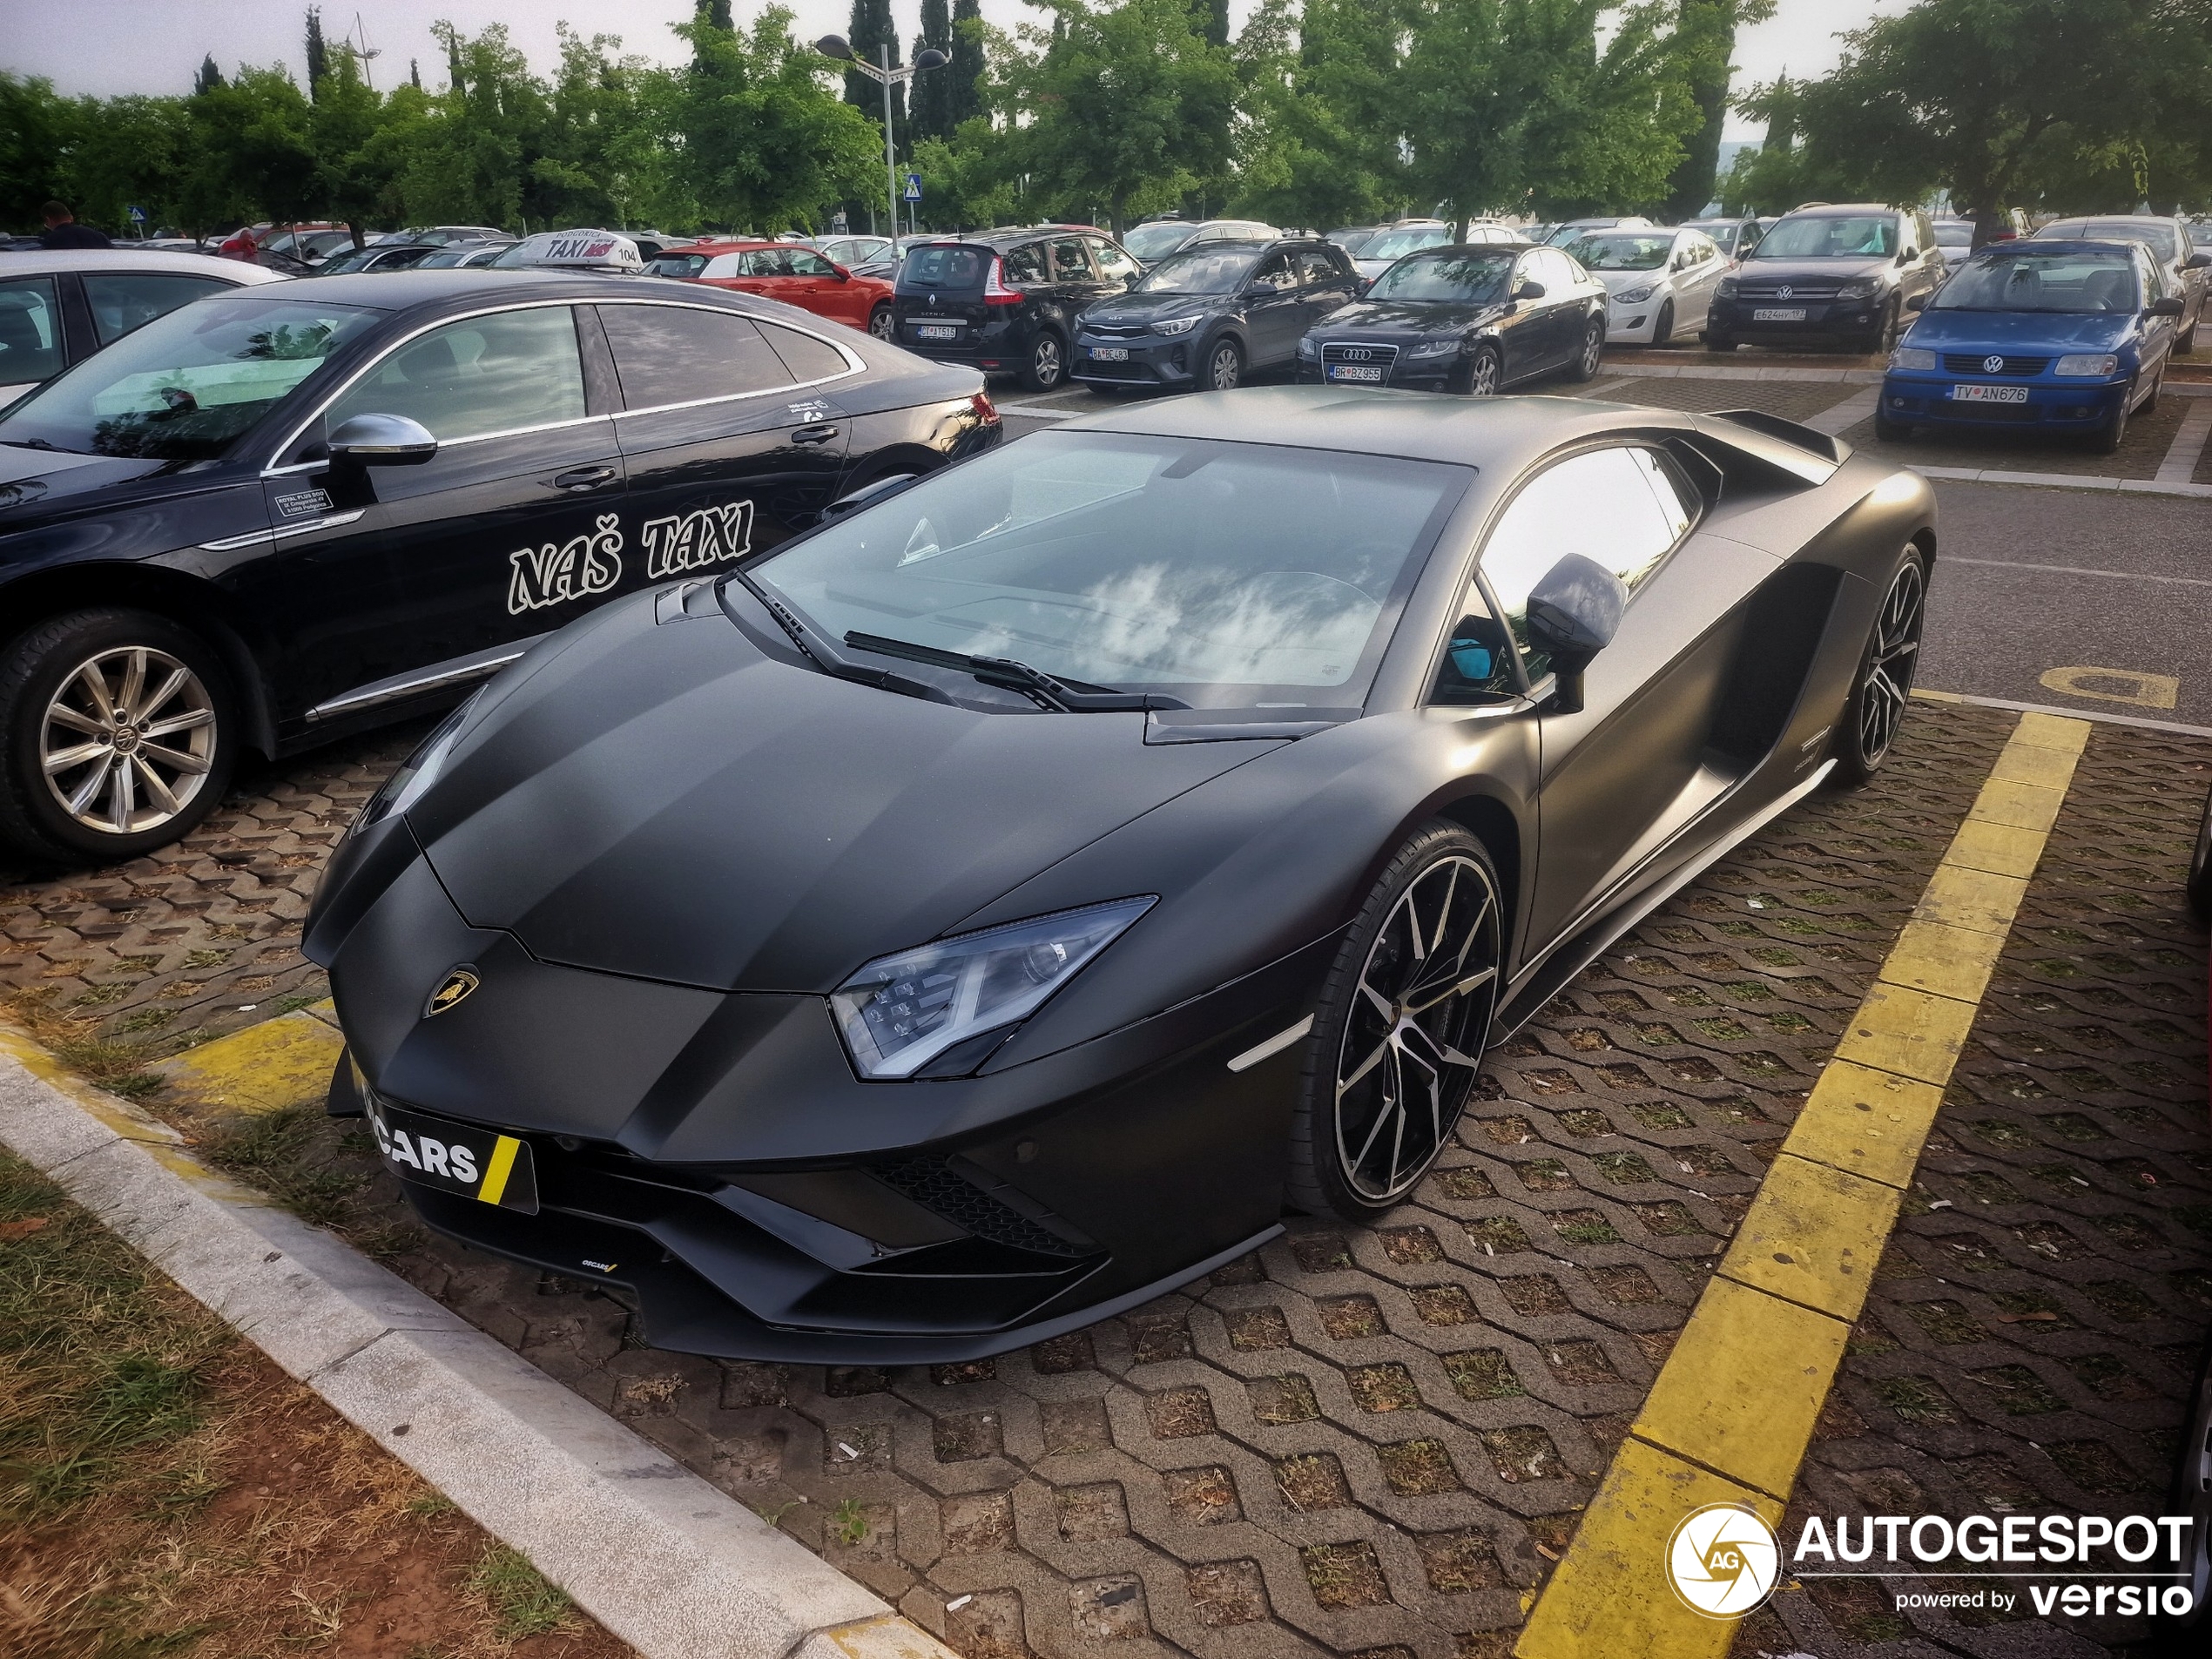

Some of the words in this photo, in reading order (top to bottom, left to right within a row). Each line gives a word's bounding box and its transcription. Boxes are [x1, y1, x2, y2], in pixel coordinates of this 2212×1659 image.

[556, 229, 602, 239] PODGORICA
[545, 239, 589, 259] TAXI
[617, 248, 637, 263] 104
[1335, 368, 1346, 377] BR
[1351, 368, 1380, 379] BZ955
[1956, 386, 1973, 399] TV
[1981, 388, 2027, 401] AN676
[278, 496, 297, 504] ROYAL
[508, 513, 624, 615] NAŠ
[642, 499, 754, 578] TAXI
[362, 1082, 479, 1184] CARS
[582, 1259, 610, 1271] OSCARS
